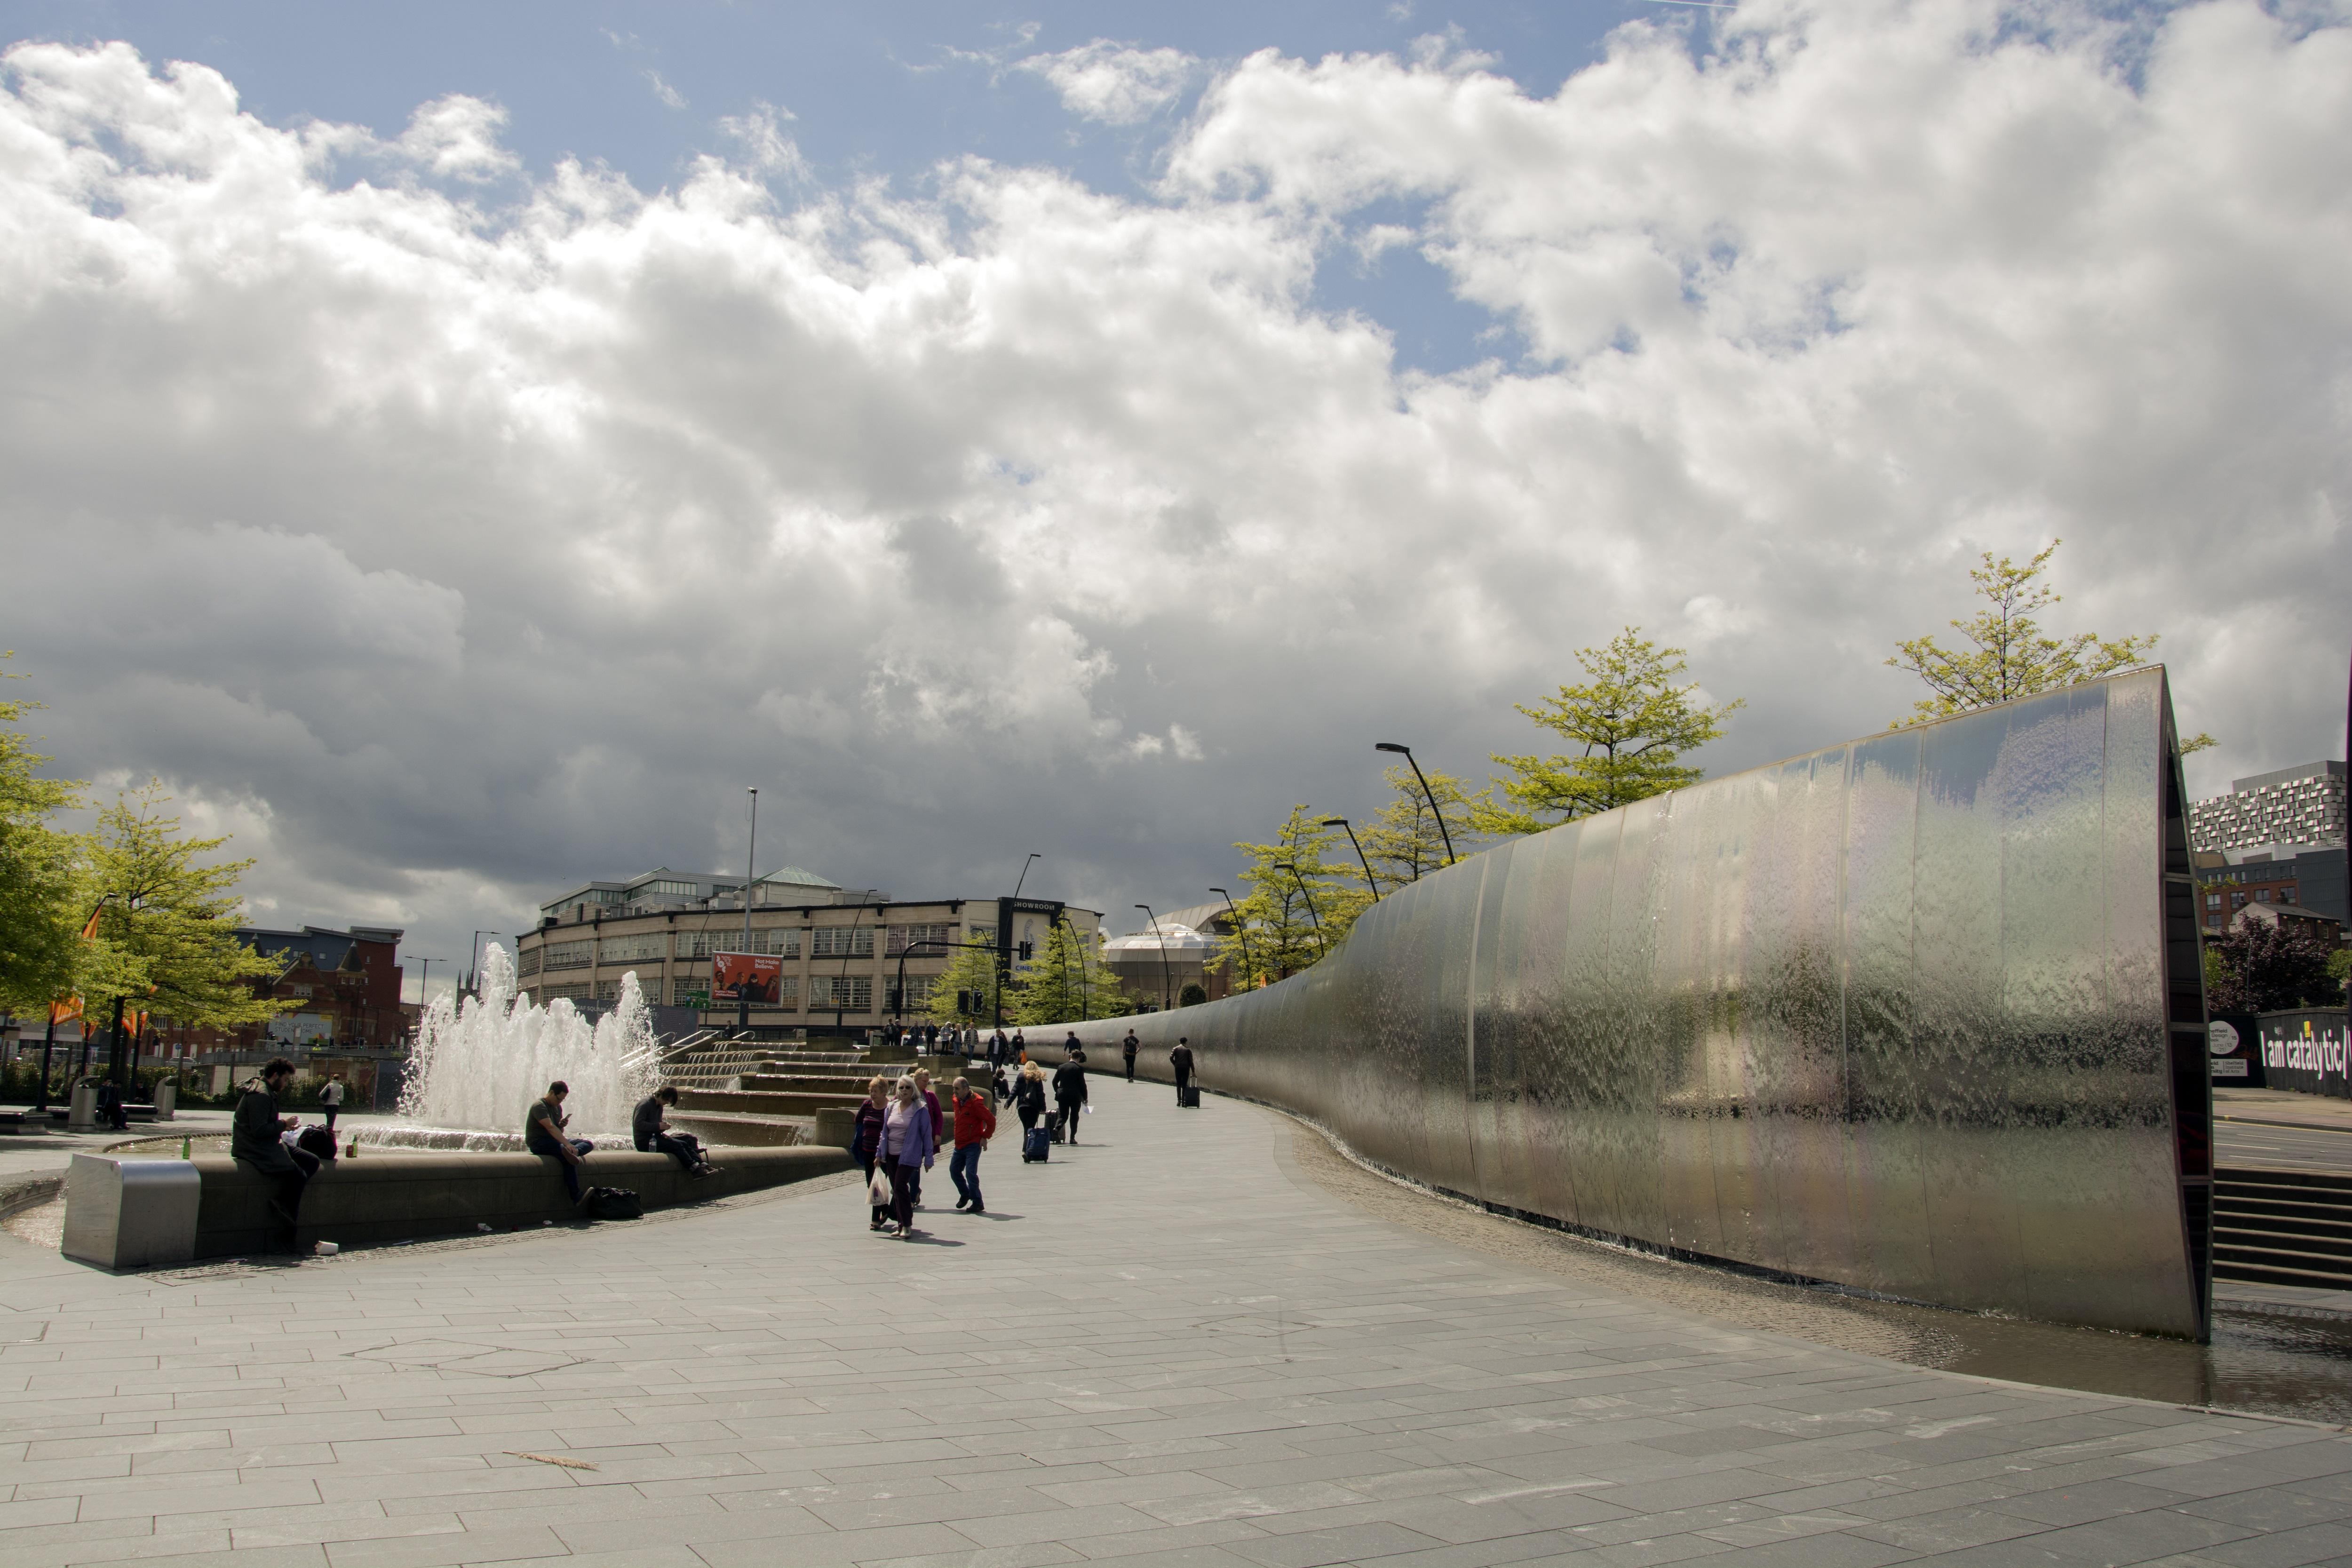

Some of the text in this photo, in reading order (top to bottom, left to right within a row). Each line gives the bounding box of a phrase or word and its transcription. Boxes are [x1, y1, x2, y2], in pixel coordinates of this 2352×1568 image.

[1013, 901, 1055, 910] SHOWROOM
[2260, 1031, 2266, 1067] I
[2267, 1040, 2285, 1067] am
